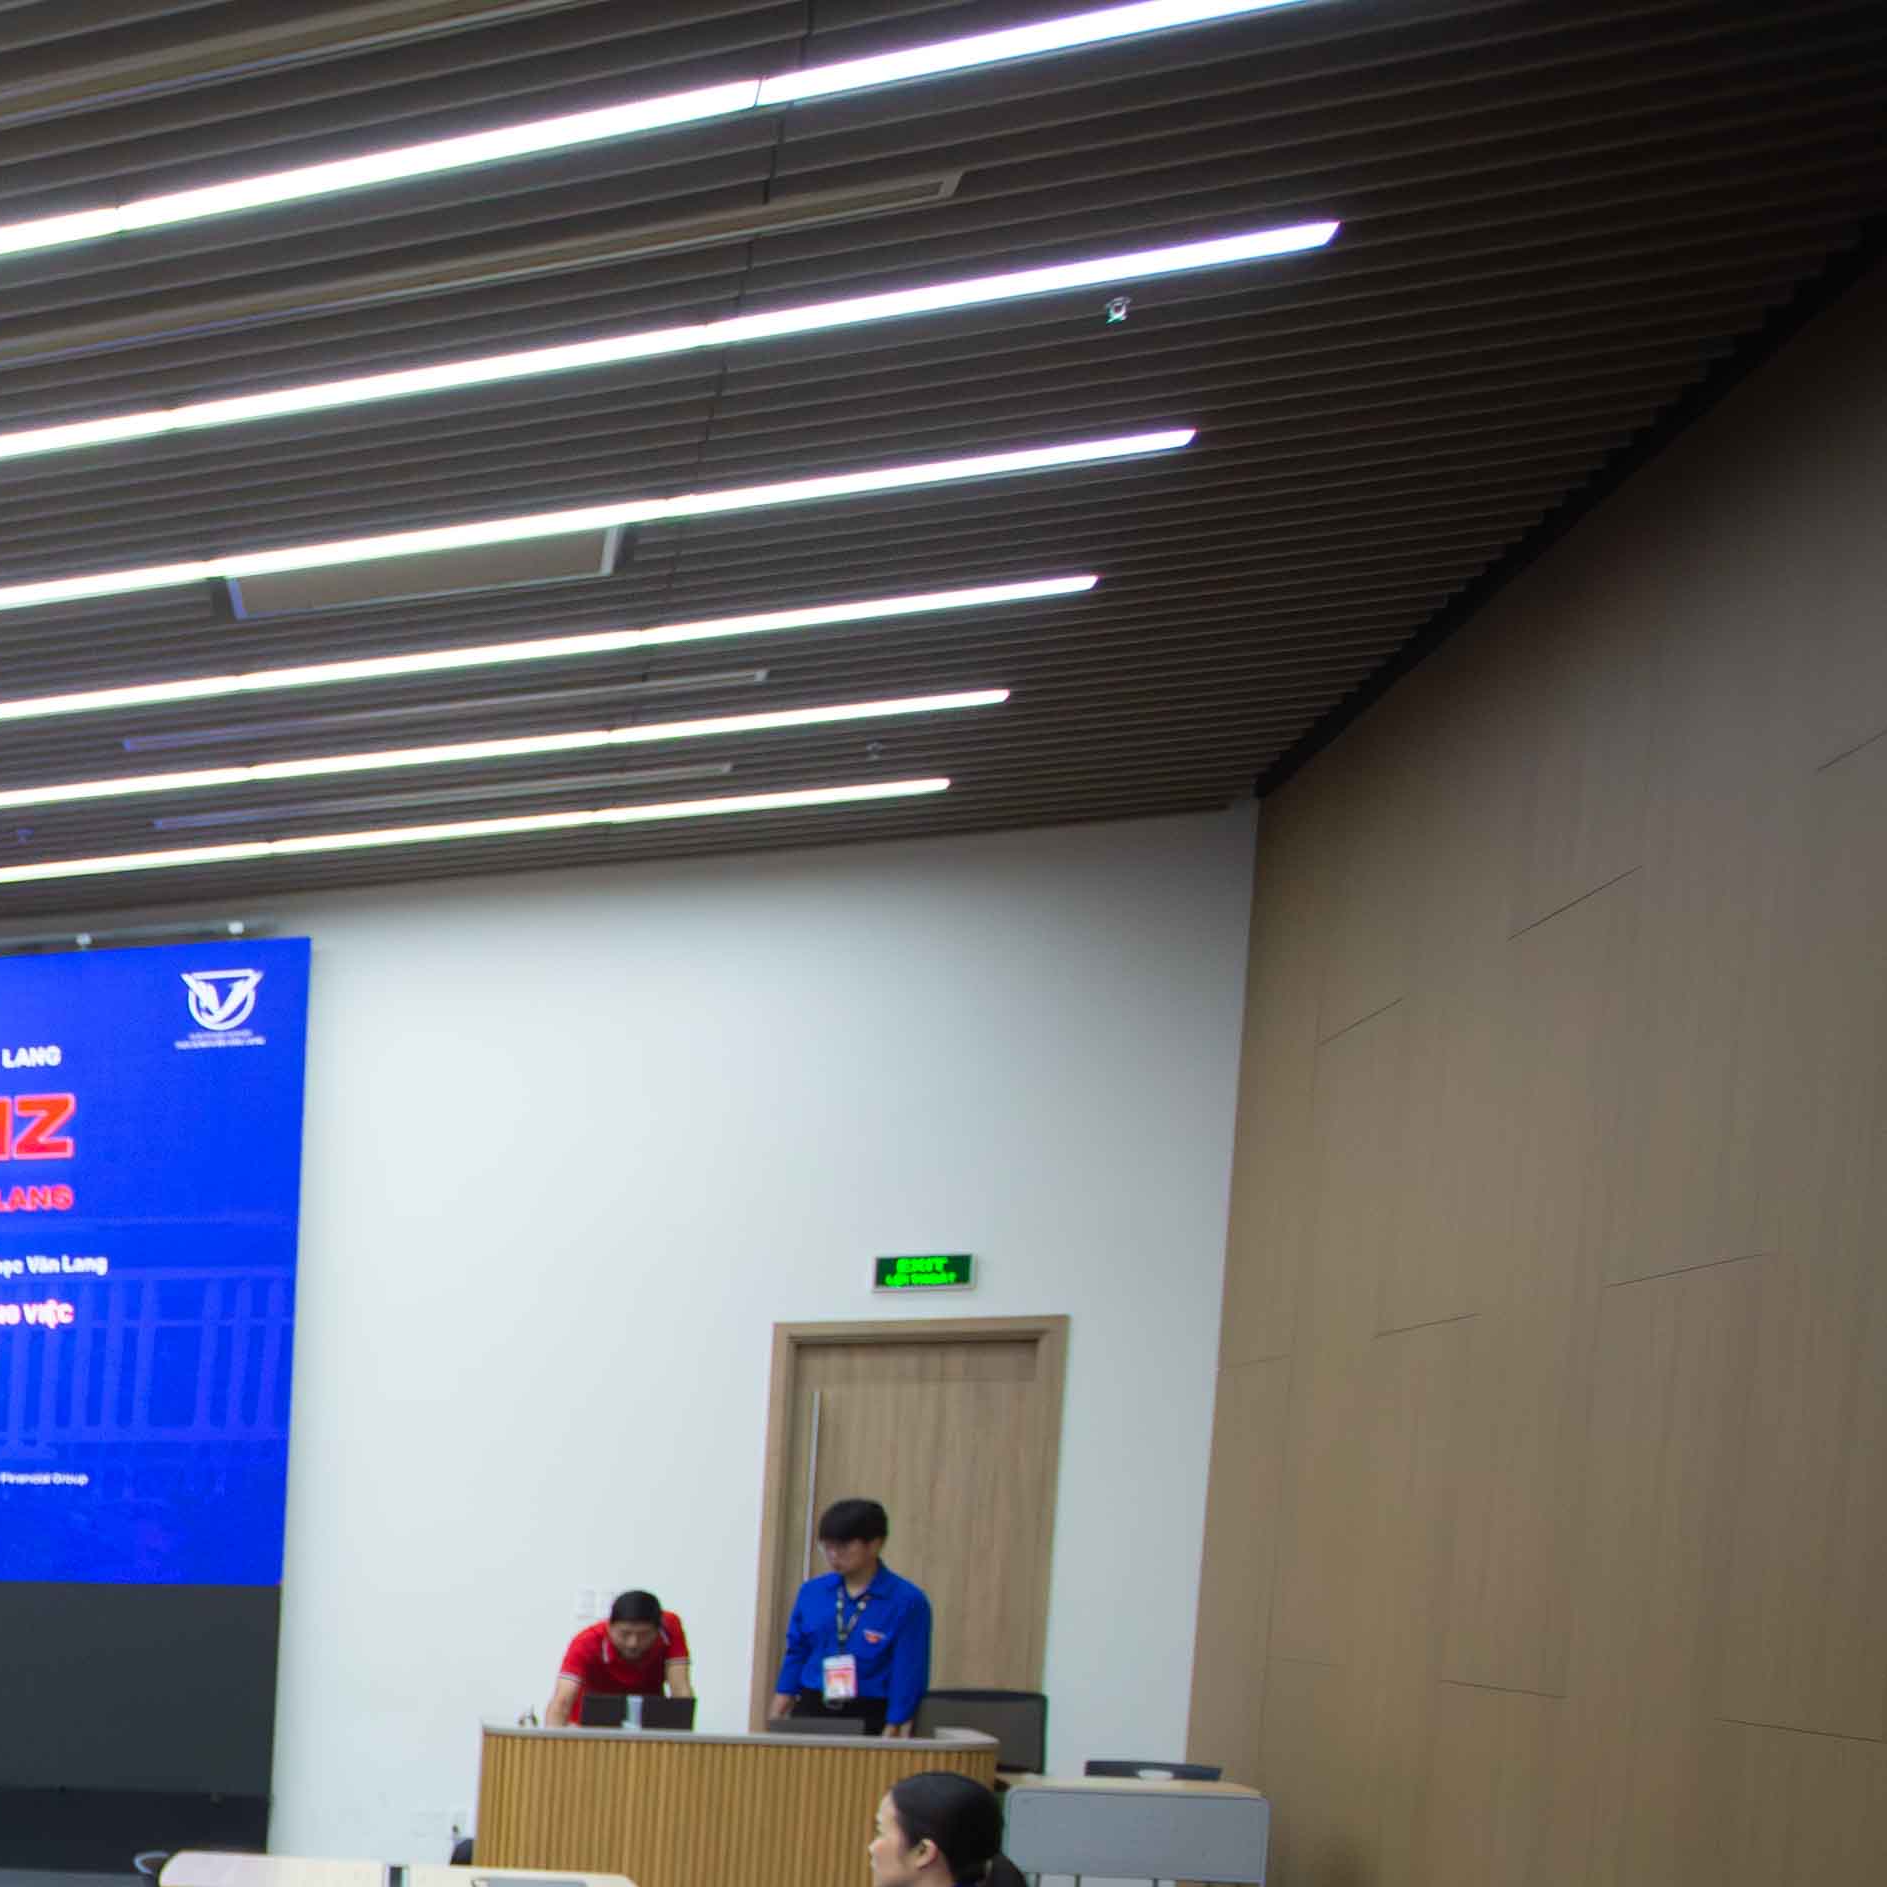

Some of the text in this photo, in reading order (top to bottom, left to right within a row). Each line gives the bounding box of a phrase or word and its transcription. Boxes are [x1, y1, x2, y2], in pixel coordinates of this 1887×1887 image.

[1, 1045, 62, 1068] LANG
[26, 1254, 60, 1275] Văn
[61, 1253, 108, 1276] Lang
[23, 1299, 73, 1328] VIỆC
